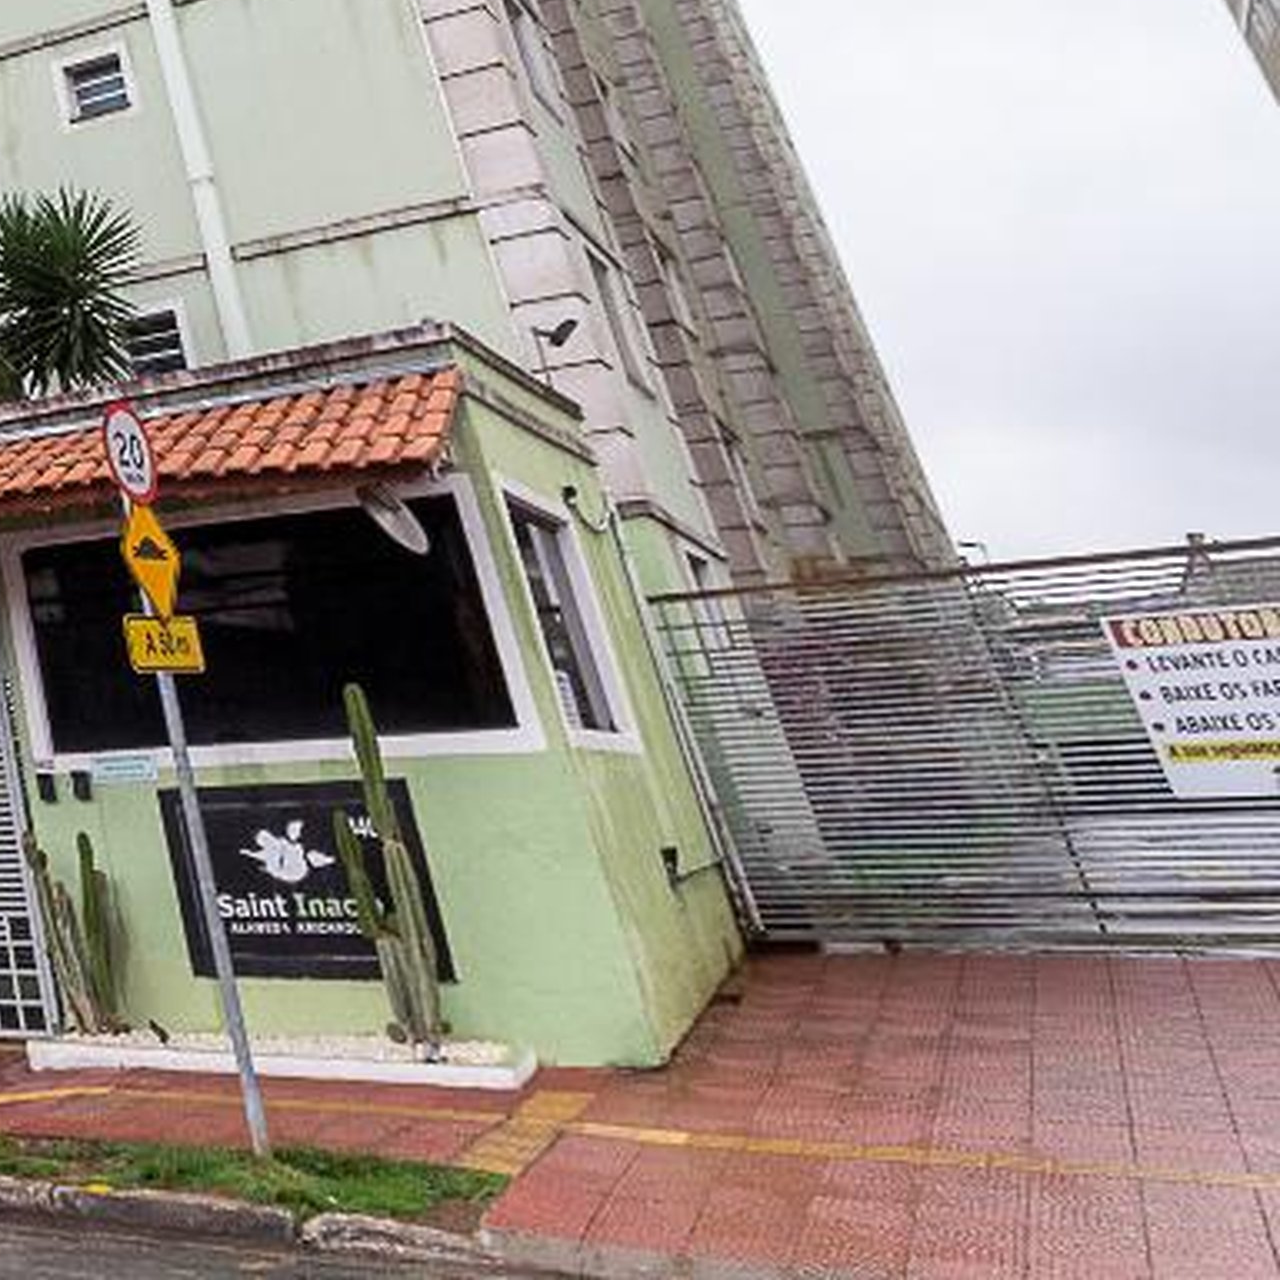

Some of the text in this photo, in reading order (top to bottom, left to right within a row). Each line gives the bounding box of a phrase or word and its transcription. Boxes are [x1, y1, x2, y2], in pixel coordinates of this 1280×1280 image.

[113, 431, 144, 469] 20
[1146, 652, 1230, 672] LEVANTE
[1233, 649, 1248, 668] O
[1160, 682, 1218, 704] BAIXE
[1220, 682, 1248, 701] OS
[1177, 713, 1244, 734] ABAIXE
[1246, 712, 1276, 731] OS
[216, 892, 384, 918] Saint Inac
